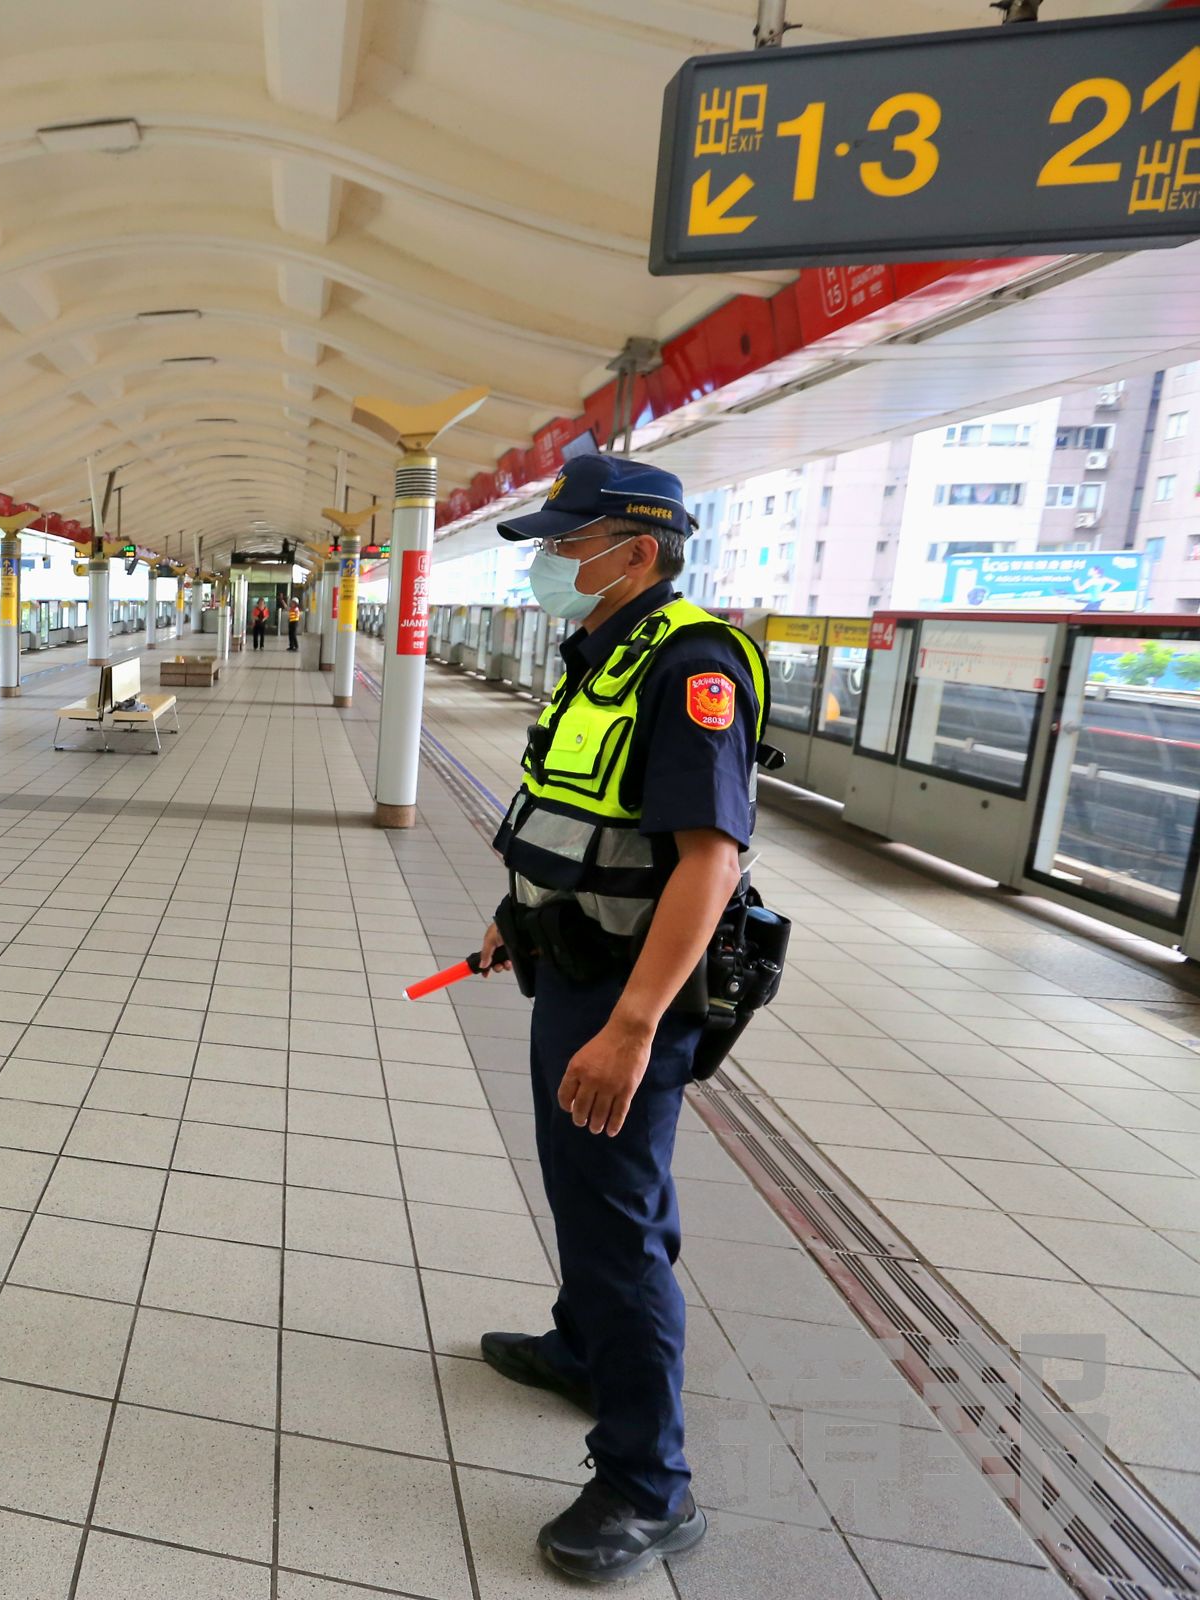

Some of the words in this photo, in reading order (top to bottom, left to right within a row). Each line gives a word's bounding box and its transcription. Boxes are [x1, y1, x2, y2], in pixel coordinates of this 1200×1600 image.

[694, 84, 768, 158] 出口
[1036, 77, 1132, 188] 2
[728, 133, 764, 153] EXIT
[1127, 138, 1200, 215] 出口
[1167, 190, 1200, 211] EXI
[827, 284, 842, 307] 15
[884, 623, 894, 646] 4
